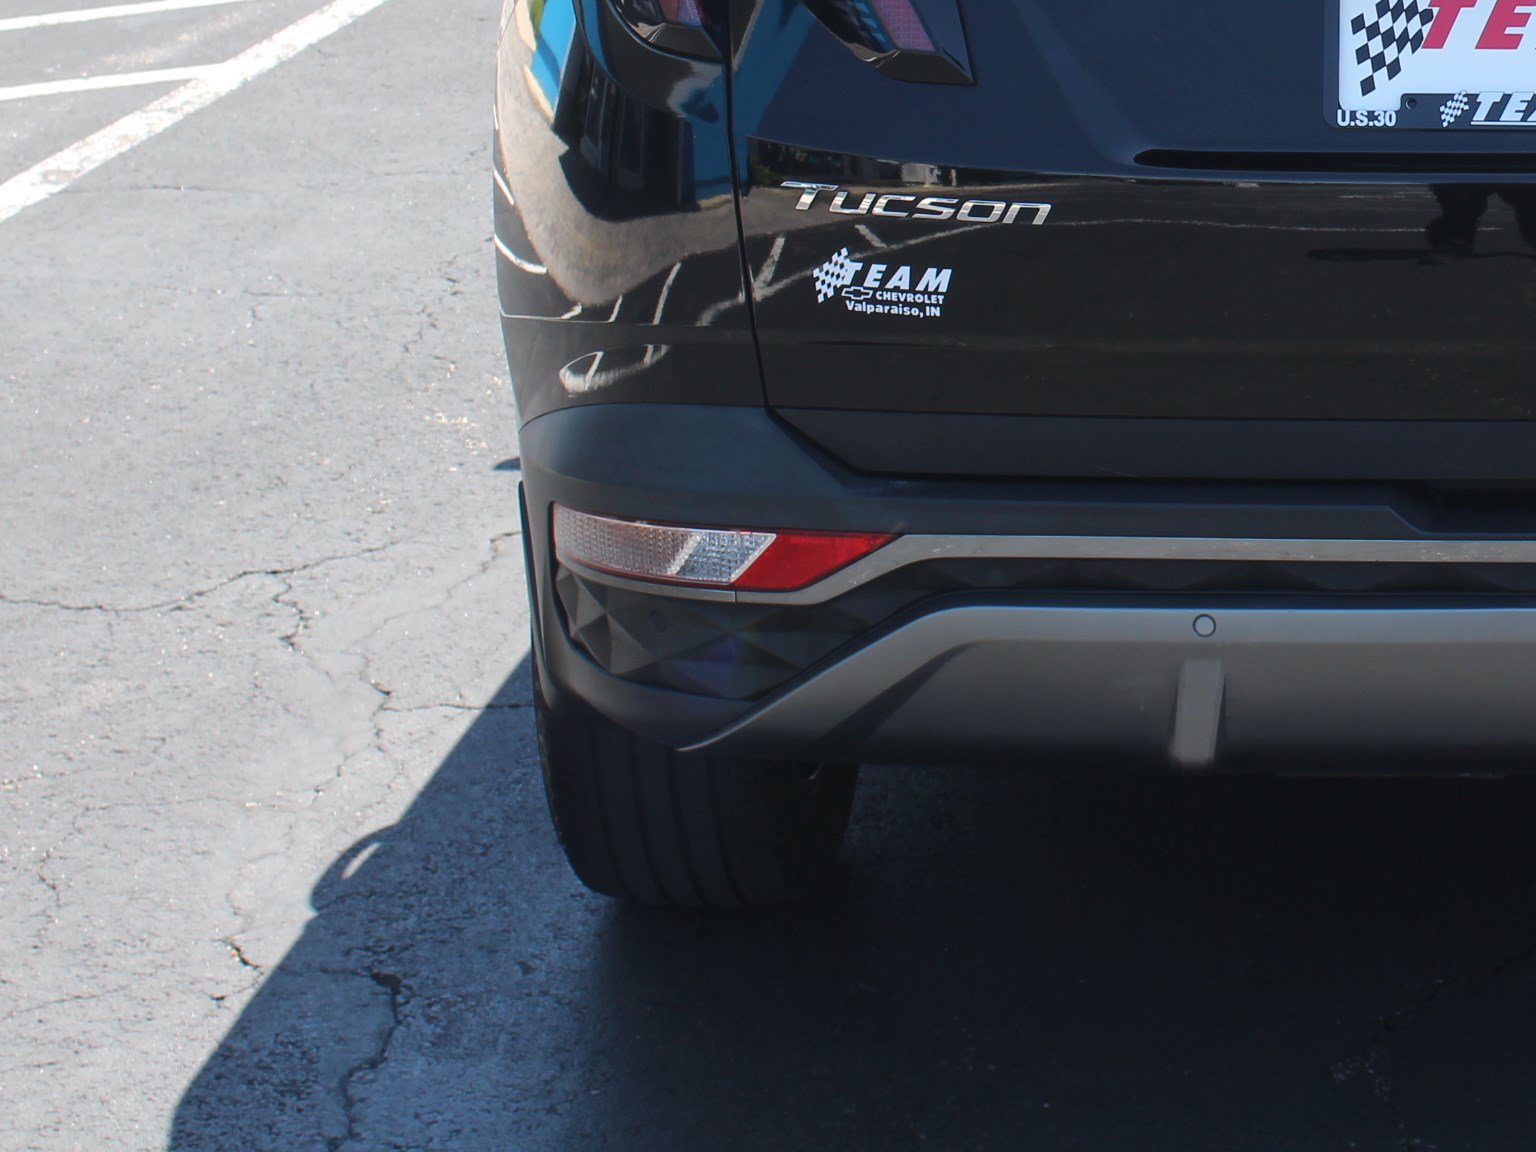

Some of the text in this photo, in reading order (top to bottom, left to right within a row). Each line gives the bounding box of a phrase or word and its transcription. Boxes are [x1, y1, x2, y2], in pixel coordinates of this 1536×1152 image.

[1336, 110, 1397, 127] U.S.30
[841, 261, 952, 293] TEAM
[875, 290, 945, 305] CHEVROLET
[845, 300, 941, 318] Valparaiso, IN
